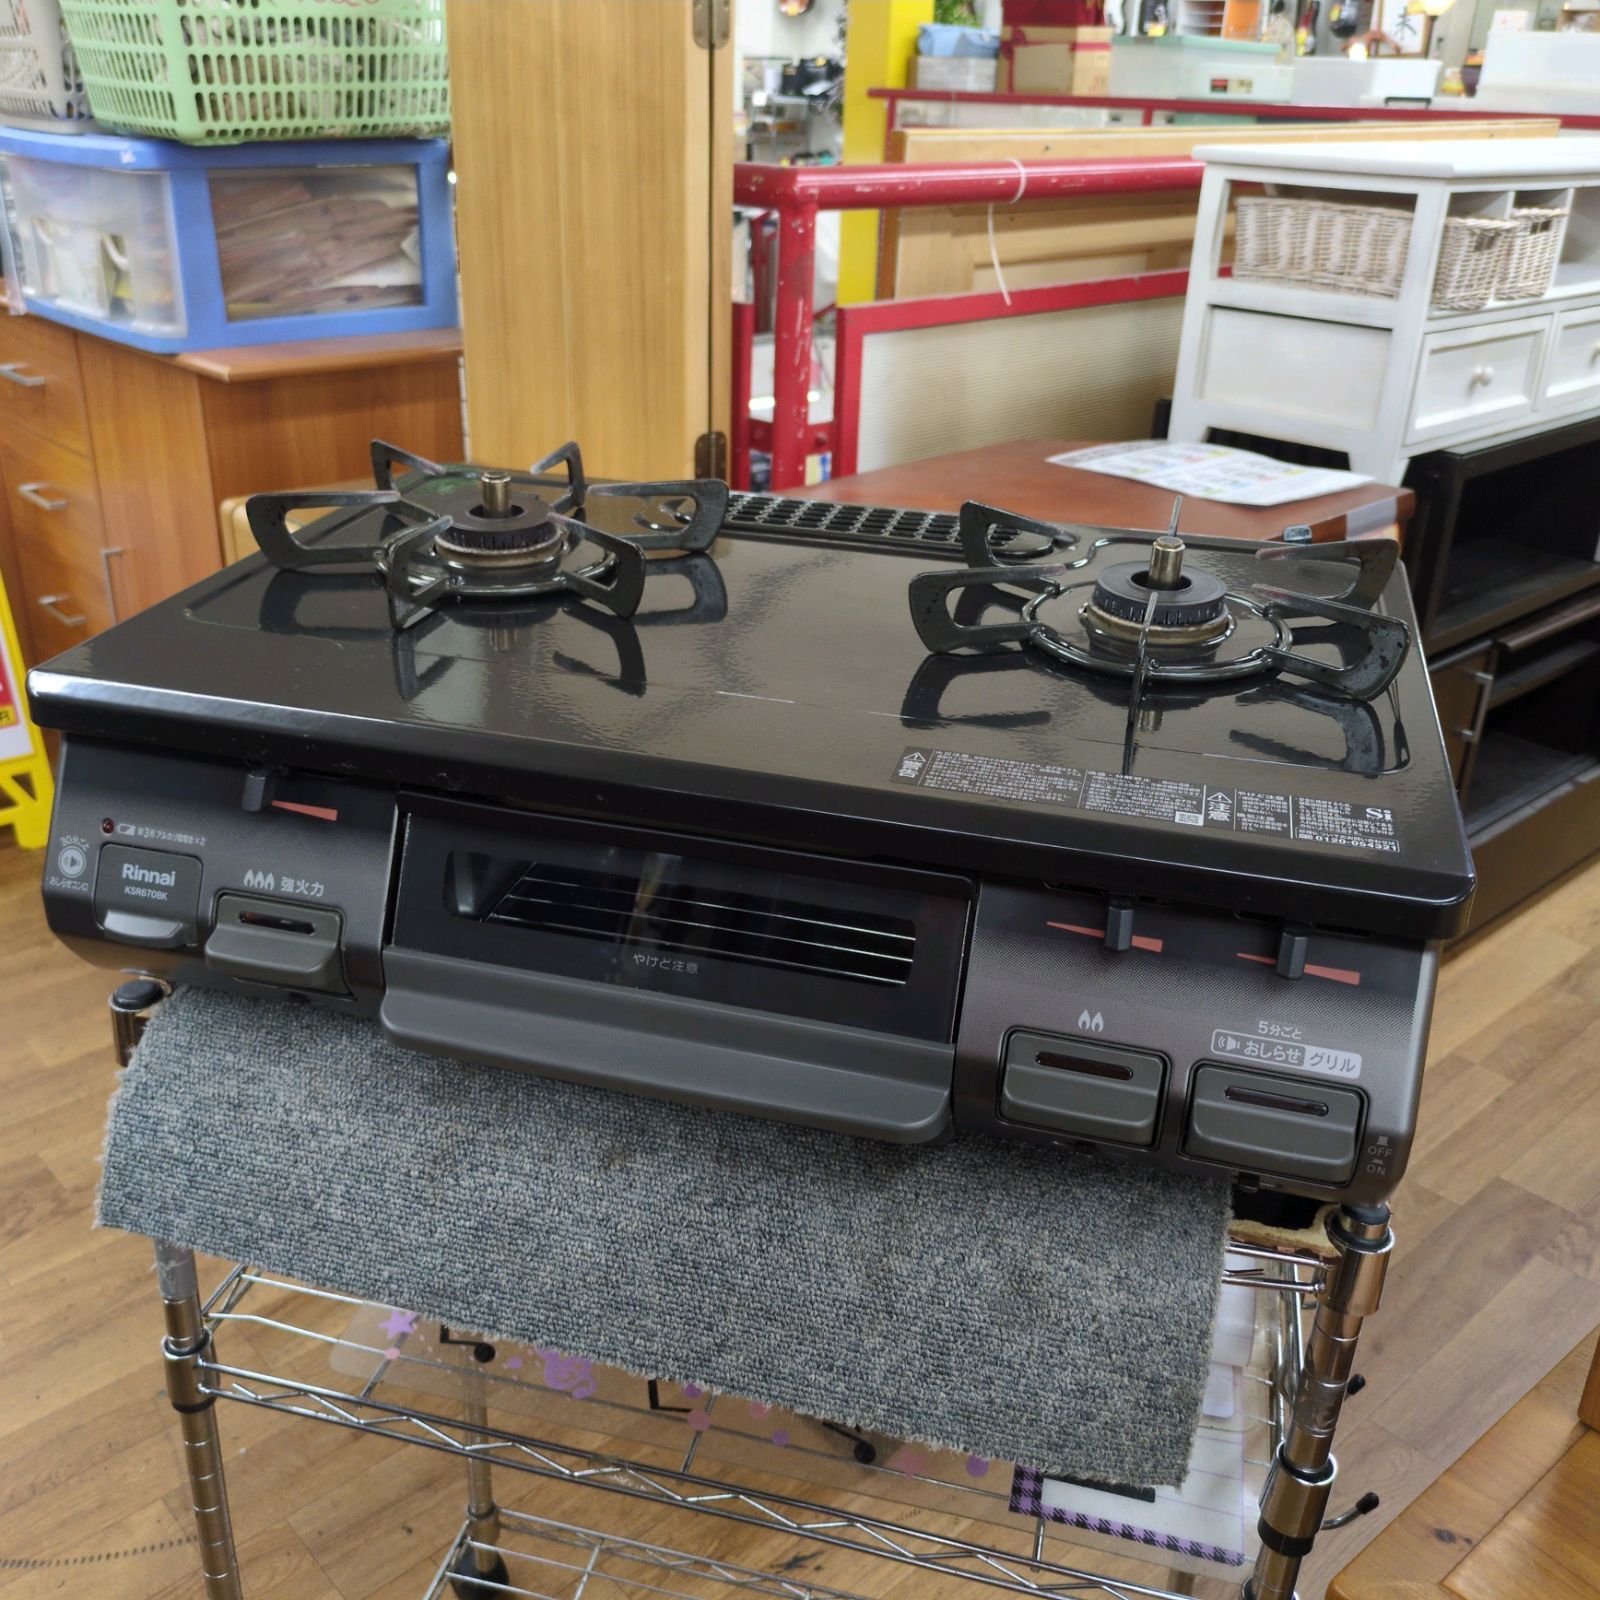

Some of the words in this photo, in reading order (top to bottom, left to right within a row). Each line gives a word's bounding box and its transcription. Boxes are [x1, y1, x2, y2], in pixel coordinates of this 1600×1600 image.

[1365, 807, 1393, 821] Si
[122, 863, 176, 887] Rinnai
[280, 876, 325, 897] 強火力
[632, 953, 699, 975] やけど注意
[1257, 1020, 1303, 1040] 5分ごと
[1243, 1040, 1301, 1064] おしらせ
[1309, 1052, 1357, 1073] グリル
[1367, 1146, 1393, 1158] OFF
[1366, 1163, 1387, 1176] ON
